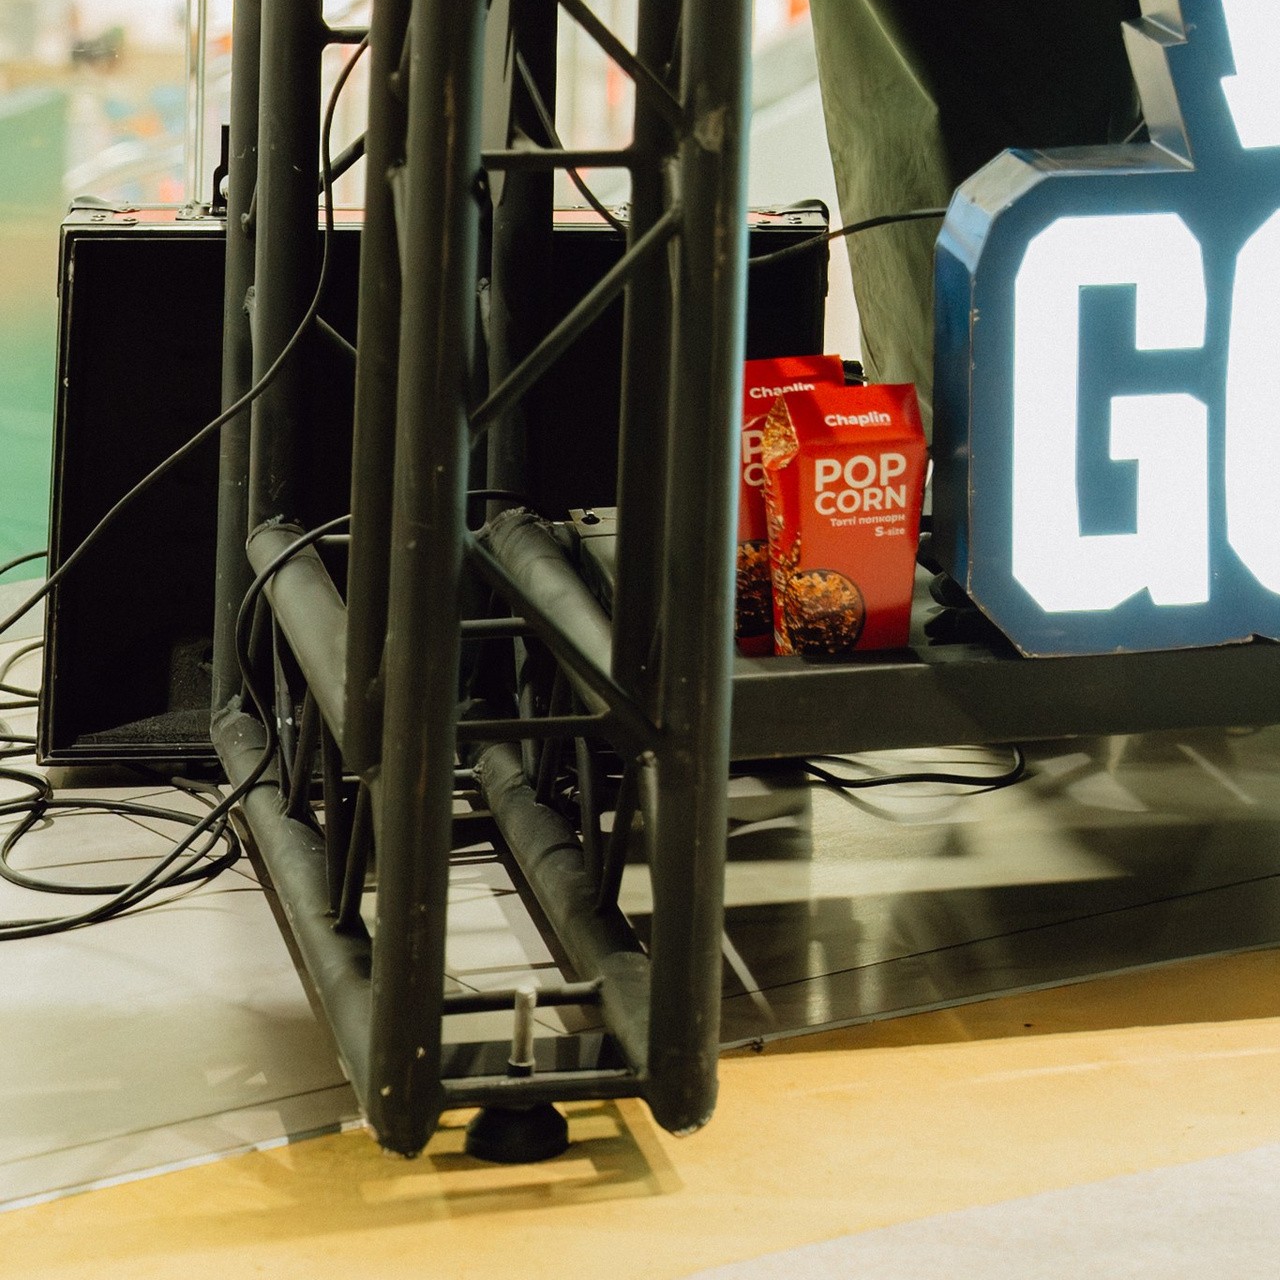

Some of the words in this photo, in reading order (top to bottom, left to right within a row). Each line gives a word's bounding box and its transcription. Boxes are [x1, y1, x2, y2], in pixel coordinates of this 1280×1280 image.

[824, 411, 892, 427] Chaplin
[815, 453, 907, 493] POP
[815, 485, 907, 515] CORN
[859, 513, 906, 526] попкорн
